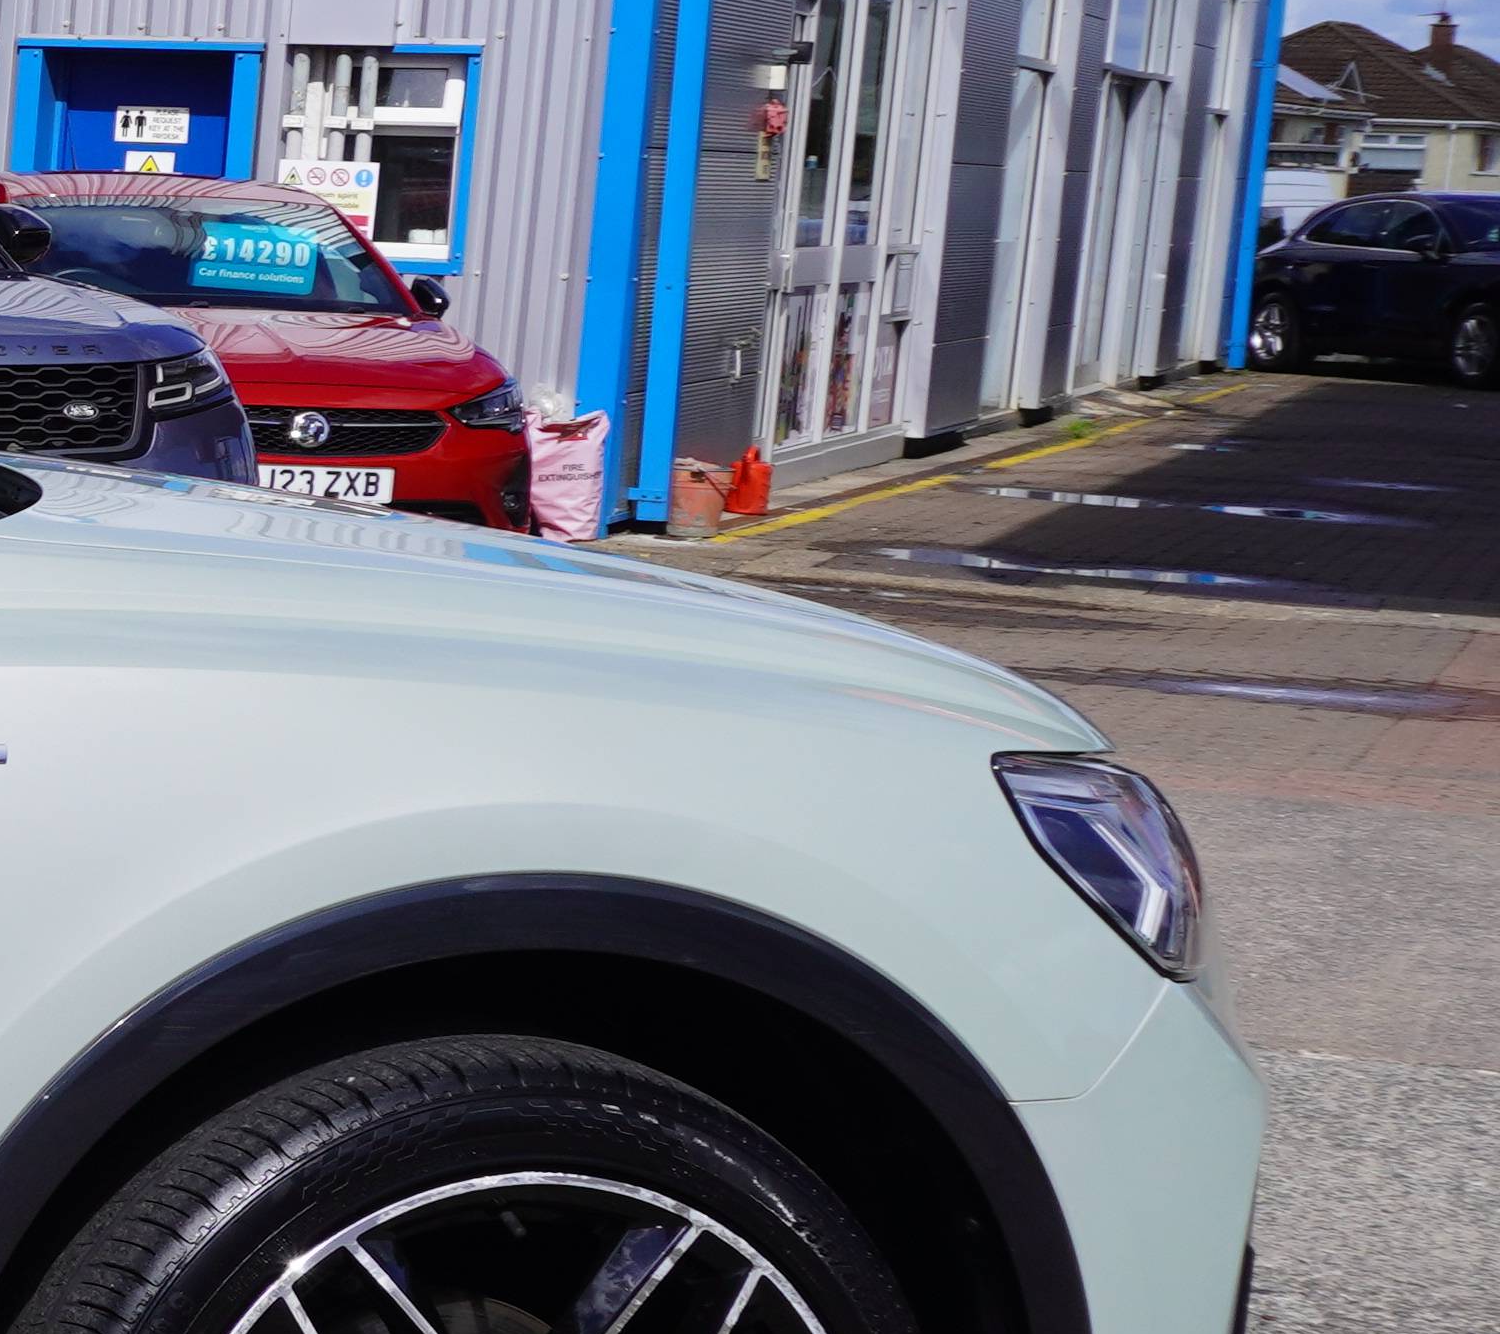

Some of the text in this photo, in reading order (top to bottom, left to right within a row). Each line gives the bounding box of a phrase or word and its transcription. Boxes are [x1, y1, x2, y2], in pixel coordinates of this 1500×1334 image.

[199, 267, 304, 284] Car finance solutions
[562, 464, 586, 472] FIRE
[323, 470, 380, 499] ZXB
